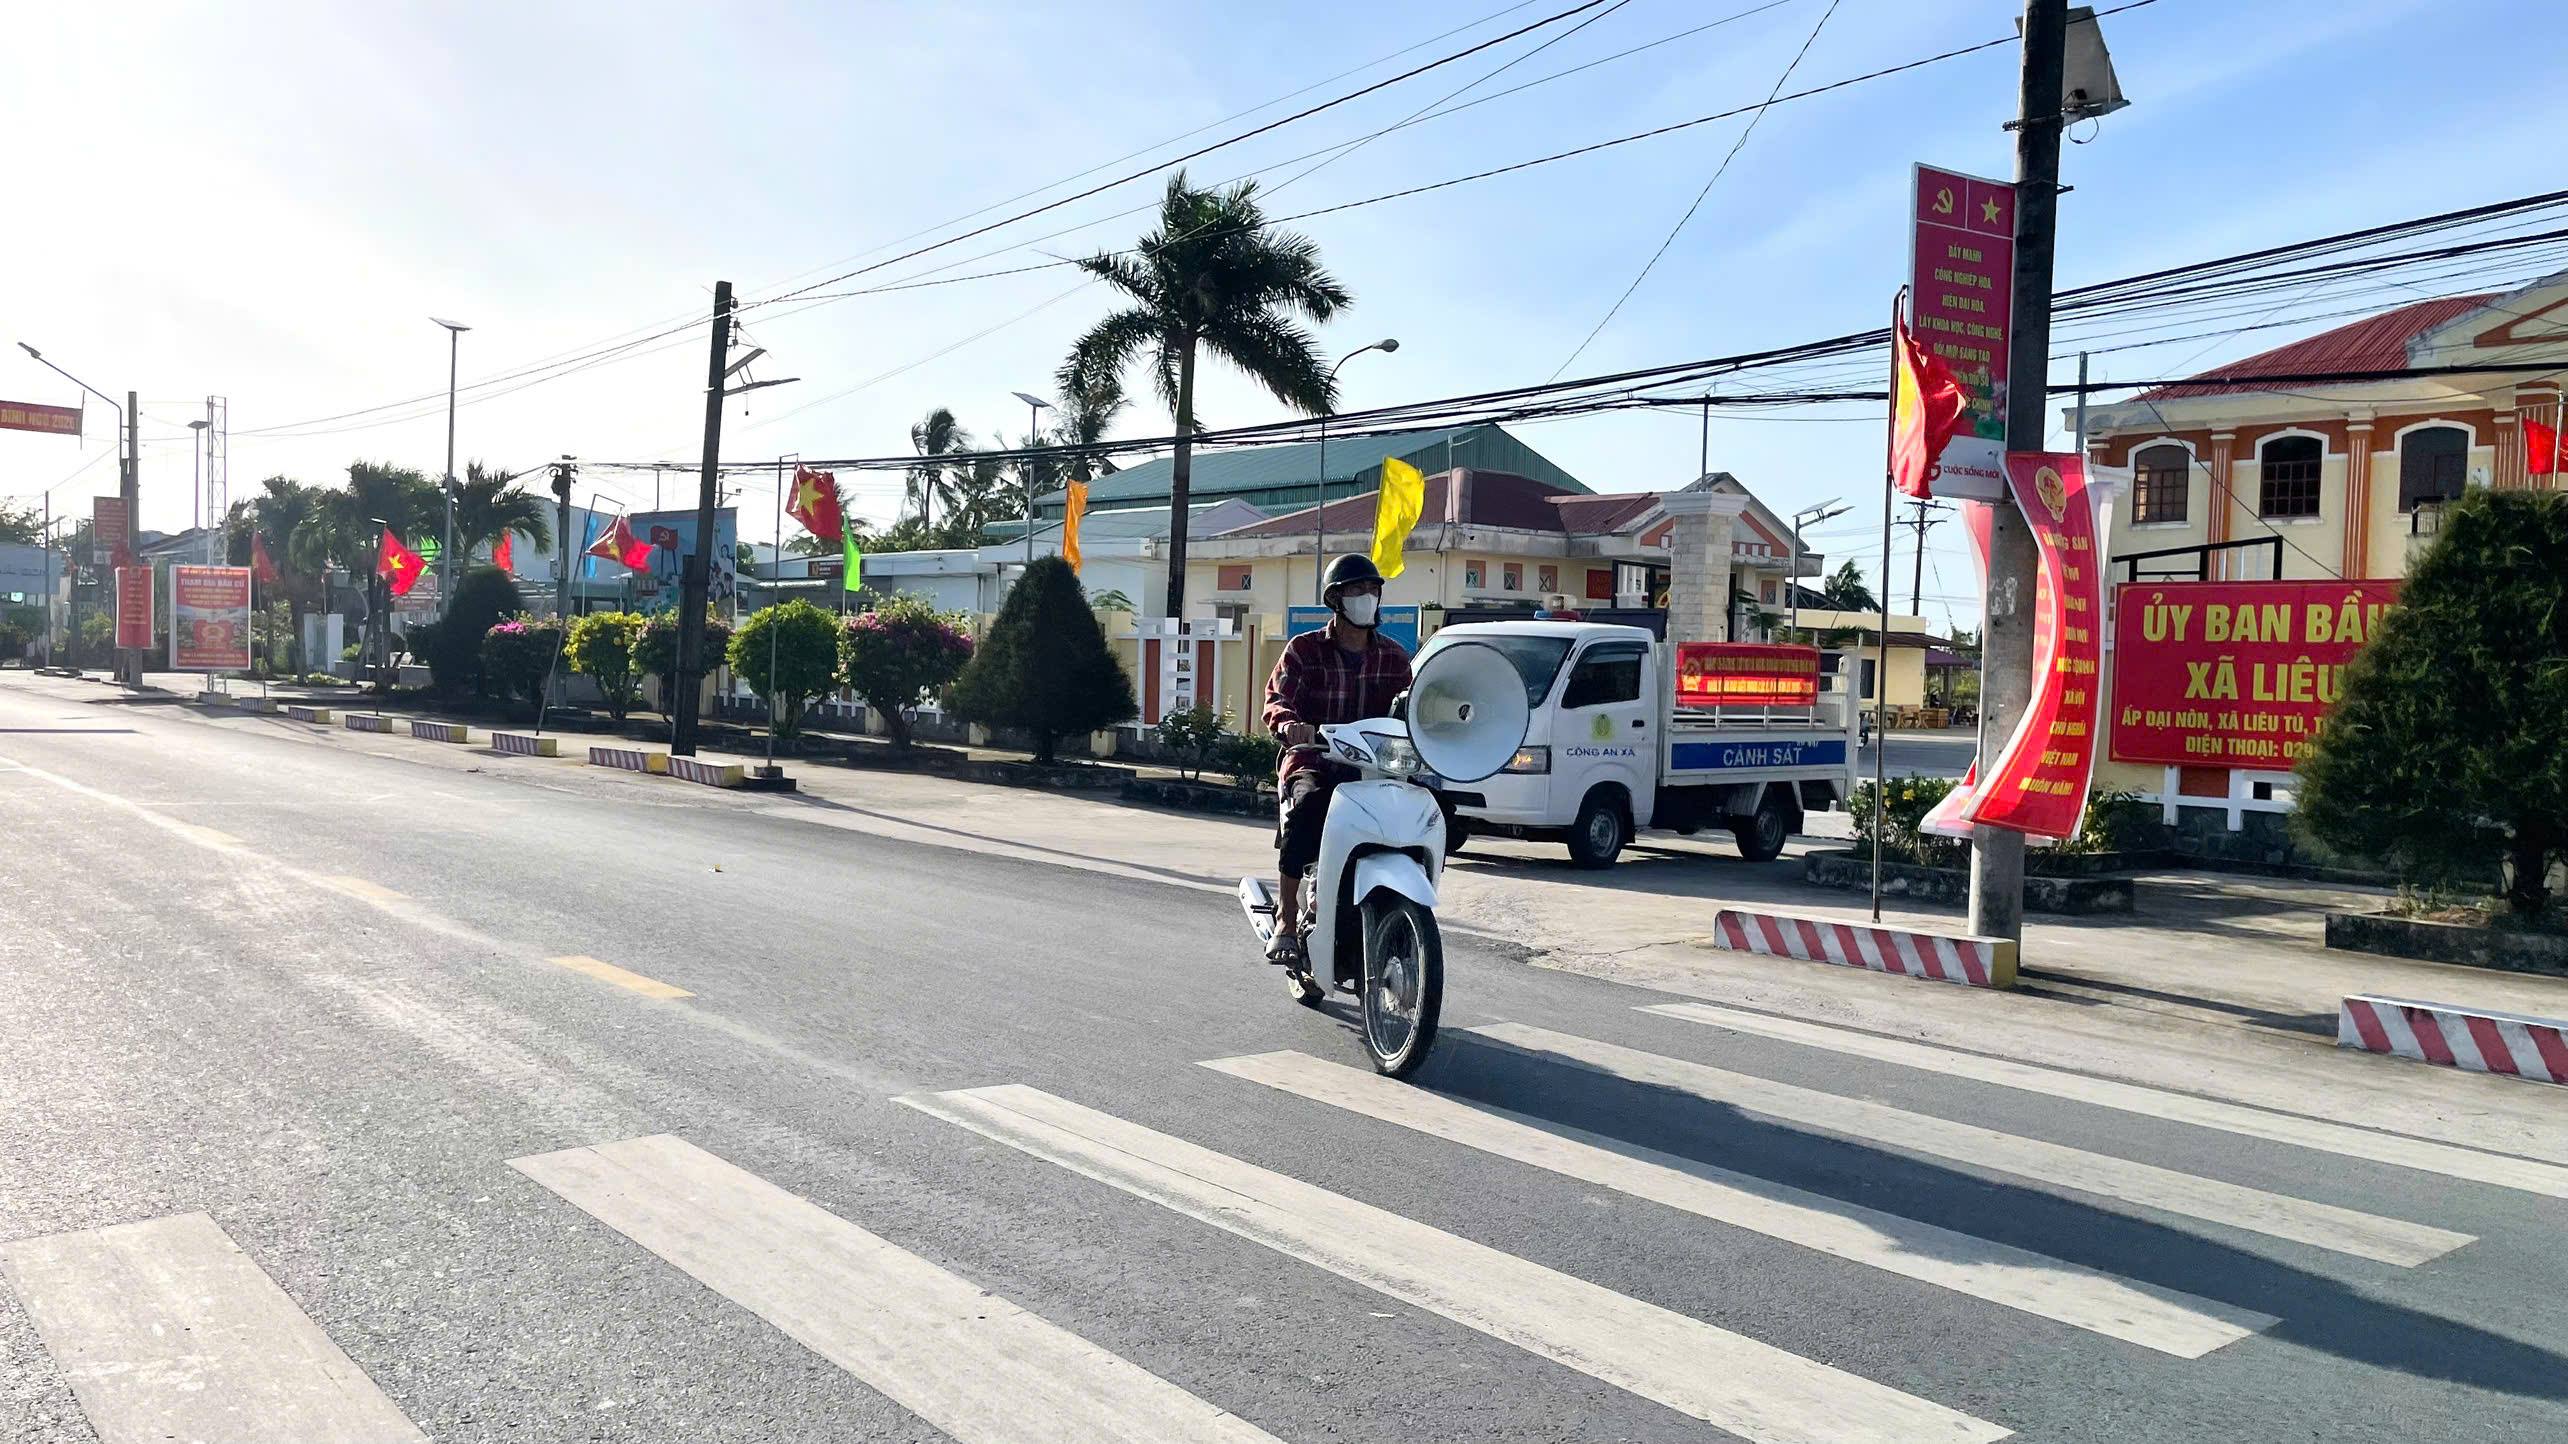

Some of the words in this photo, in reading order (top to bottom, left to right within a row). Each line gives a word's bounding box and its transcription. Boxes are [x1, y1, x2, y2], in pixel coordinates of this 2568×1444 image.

[2143, 592, 2193, 642] ỦY
[2205, 604, 2291, 643] BAN
[2184, 655, 2239, 700] XÃ
[2252, 655, 2345, 703] LIÊU
[2122, 704, 2142, 726] ẤP
[2145, 711, 2171, 731] ĐẠI
[2218, 710, 2239, 730] XÃ
[2243, 711, 2279, 732] LIÊU
[1566, 746, 1600, 757] CÔNG
[1603, 748, 1618, 757] AN
[1723, 743, 1767, 767] CẢNH
[1773, 741, 1802, 765] SÁT
[2185, 734, 2223, 757] ĐIỆN
[2227, 738, 2279, 760] THOẠI:
